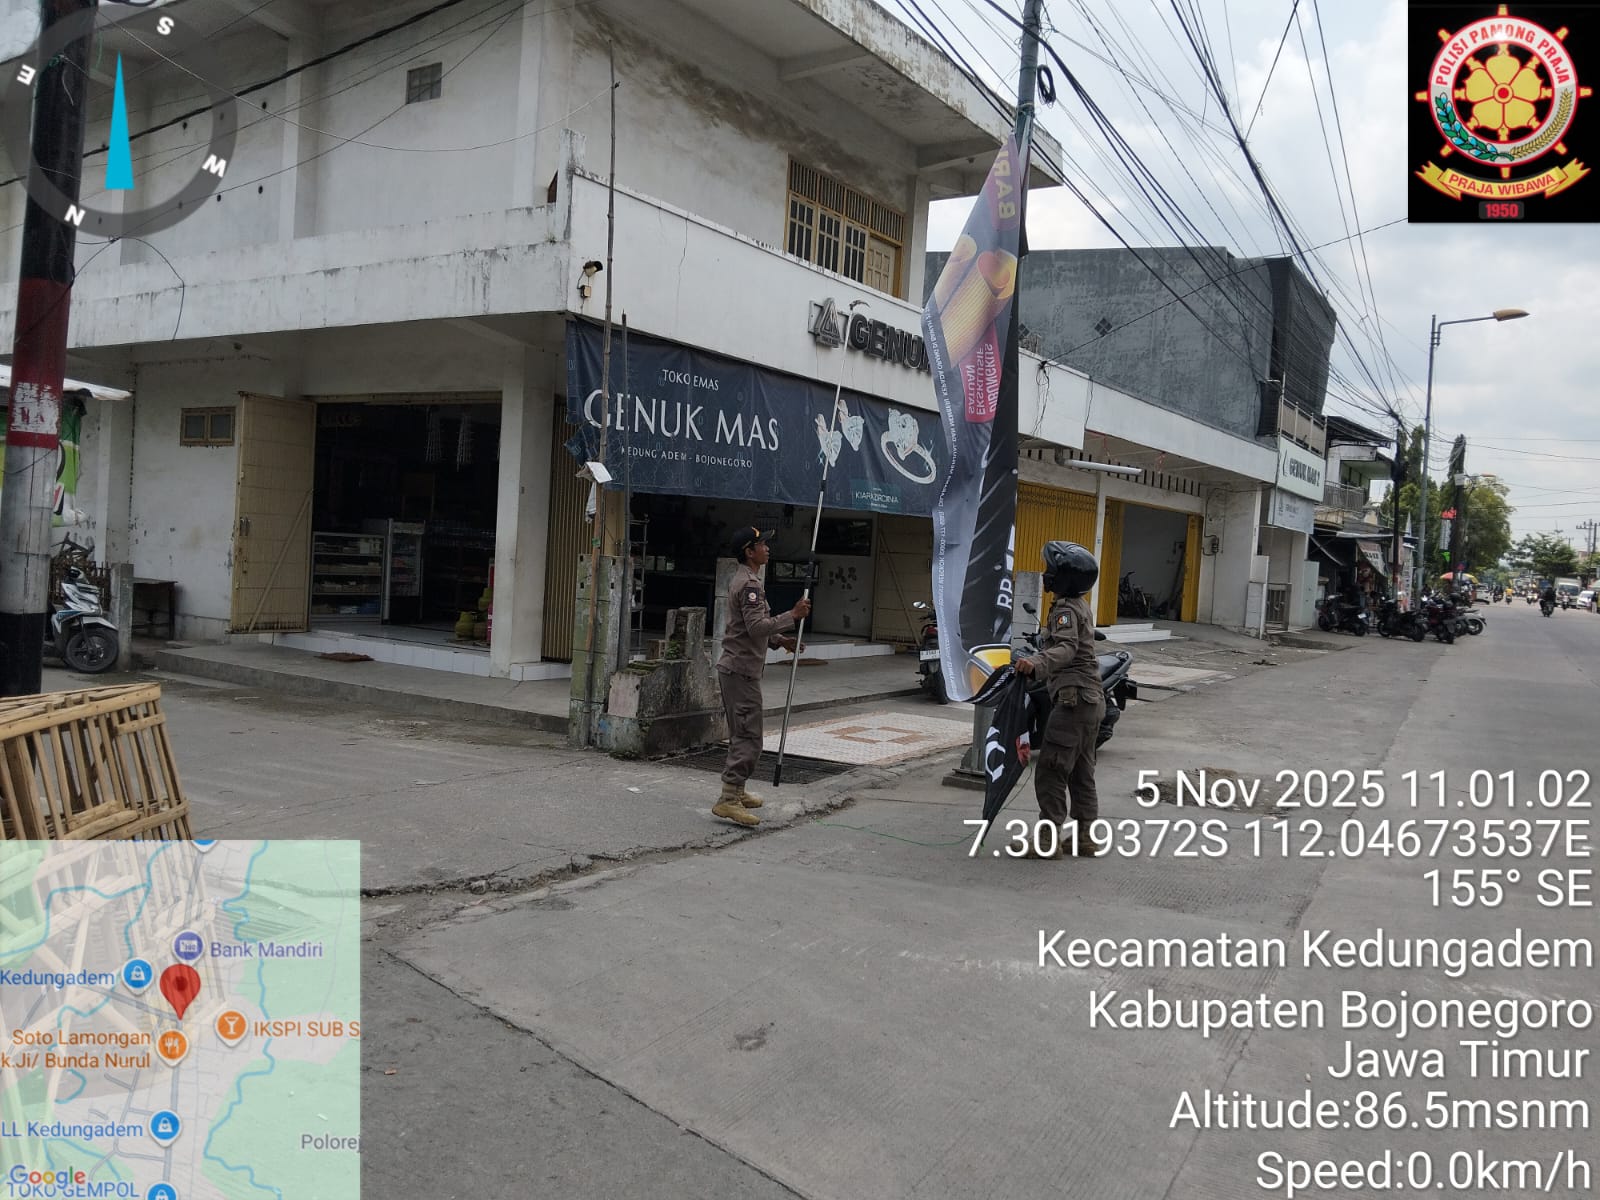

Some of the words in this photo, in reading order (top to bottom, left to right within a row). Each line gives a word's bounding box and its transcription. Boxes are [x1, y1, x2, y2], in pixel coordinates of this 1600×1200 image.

[662, 369, 691, 386] TOKO
[693, 375, 720, 392] EMAS
[583, 388, 704, 442] GENUK
[715, 409, 780, 452] MAS
[661, 450, 688, 461] ADEM
[695, 454, 753, 468] BOJONEGORO
